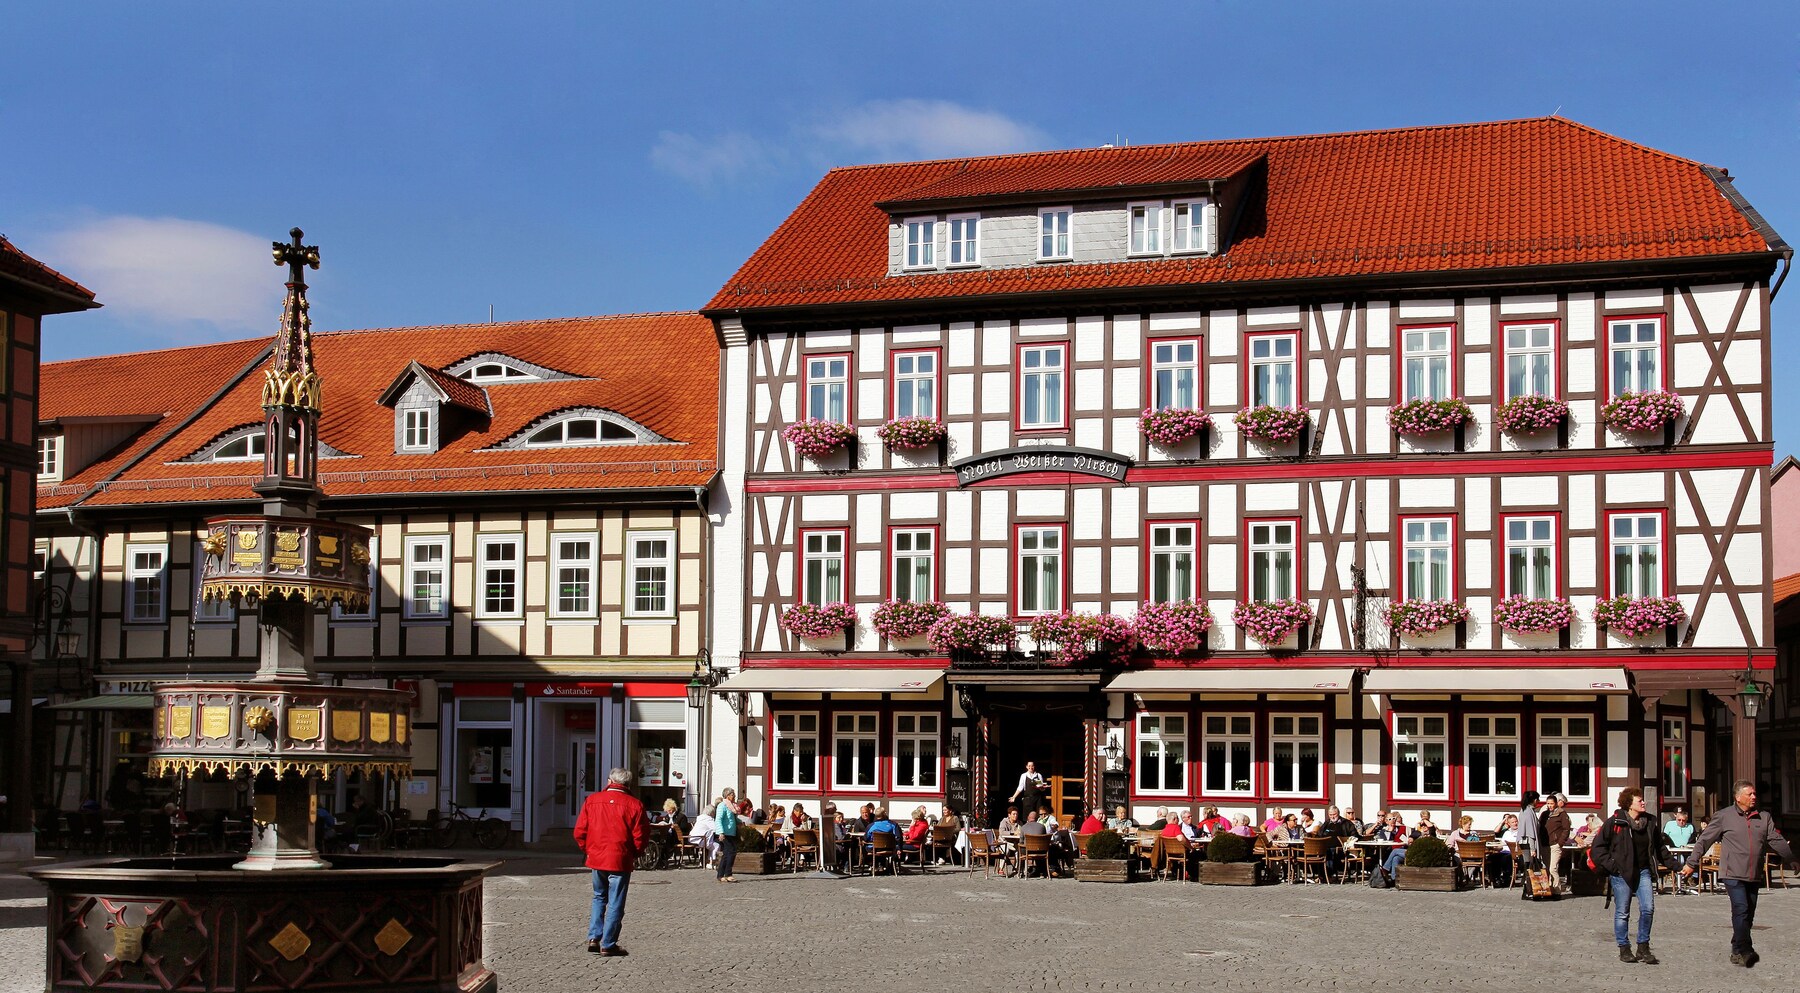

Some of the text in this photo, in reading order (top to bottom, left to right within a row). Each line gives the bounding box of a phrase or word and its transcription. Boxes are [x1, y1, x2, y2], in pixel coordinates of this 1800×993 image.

[961, 458, 1003, 480] Hotel
[1073, 454, 1119, 477] Hirsch
[556, 685, 593, 695] Santander
